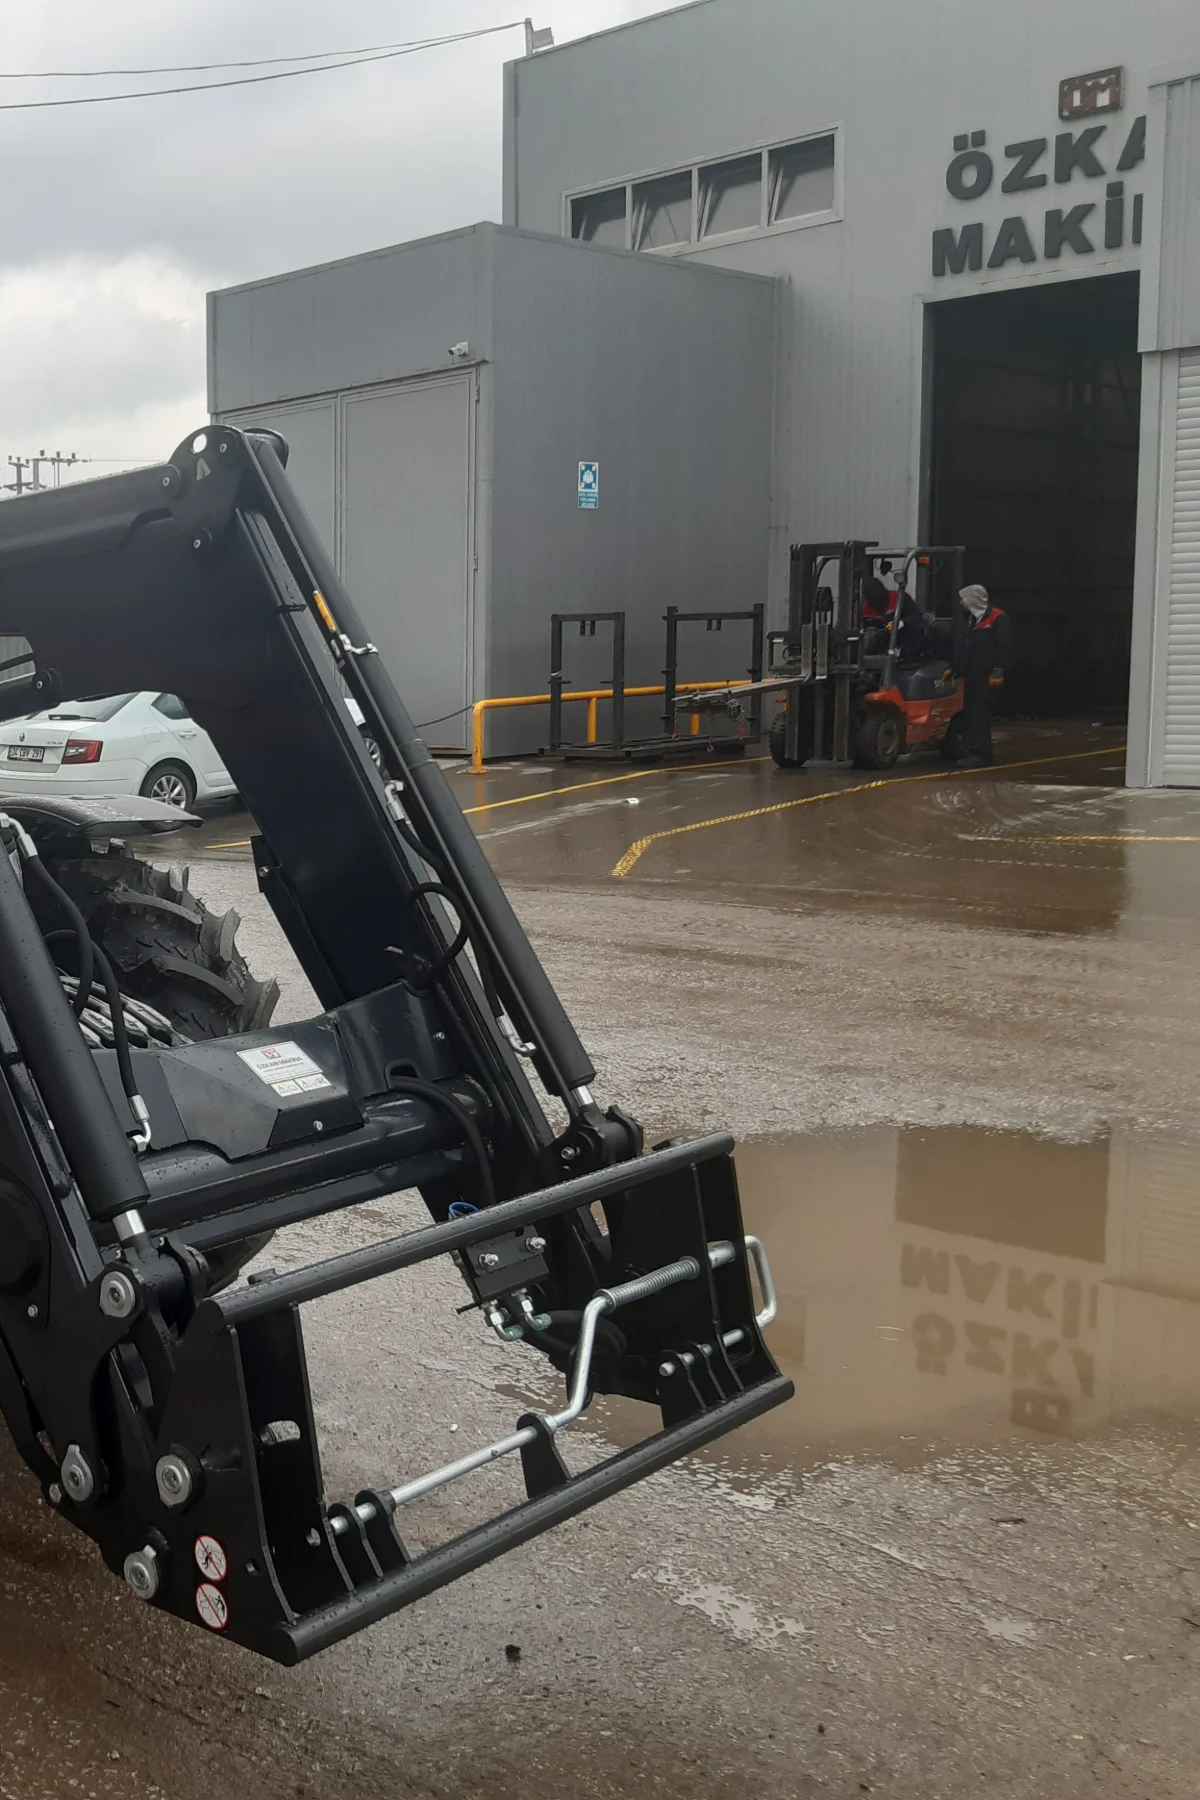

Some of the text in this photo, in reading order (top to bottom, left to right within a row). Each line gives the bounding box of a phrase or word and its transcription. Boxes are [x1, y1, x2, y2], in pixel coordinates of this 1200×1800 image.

[932, 181, 1144, 276] MAKİ
[11, 747, 18, 757] 34
[32, 749, 43, 759] 291
